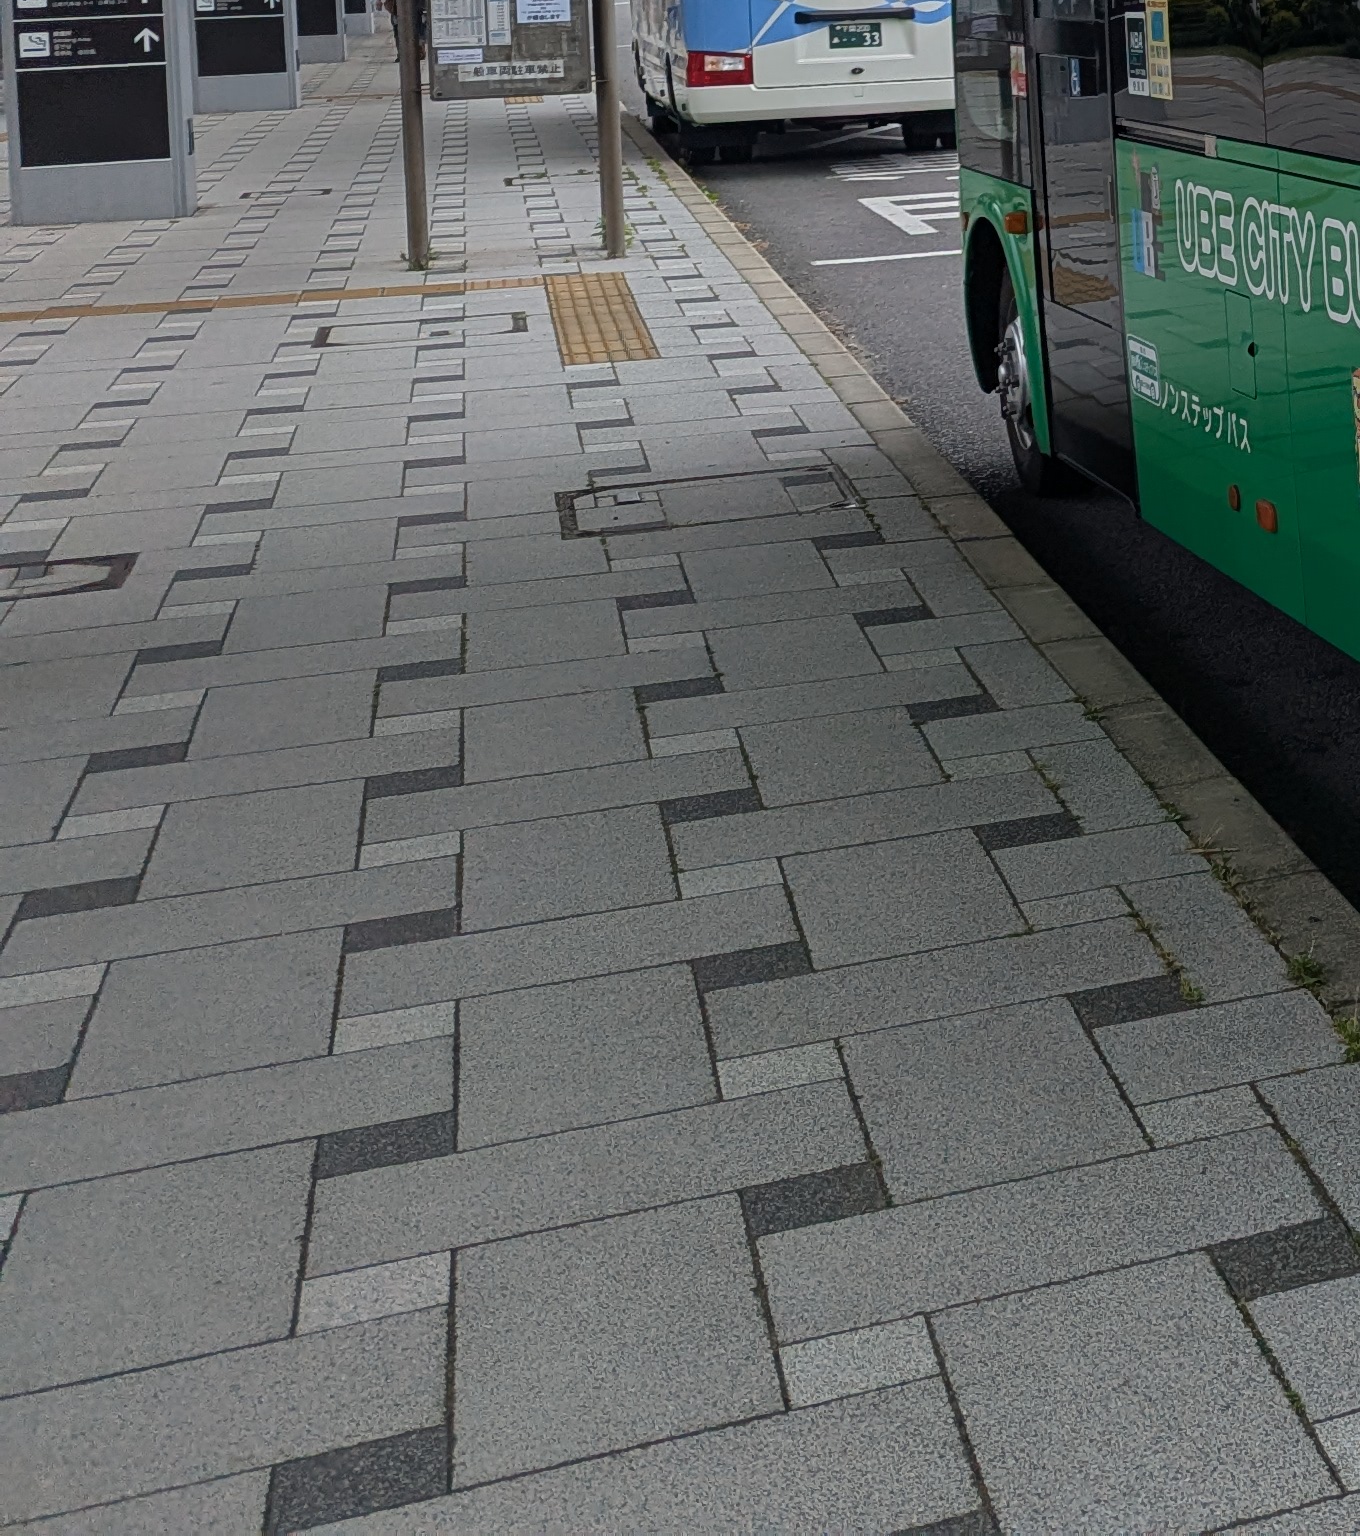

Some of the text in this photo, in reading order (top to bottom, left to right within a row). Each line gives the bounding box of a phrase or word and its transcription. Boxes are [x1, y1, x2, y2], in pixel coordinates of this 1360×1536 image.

[1174, 178, 1237, 287] UBE
[1240, 196, 1316, 313] CITY
[1160, 380, 1252, 454] ノンステップバス
